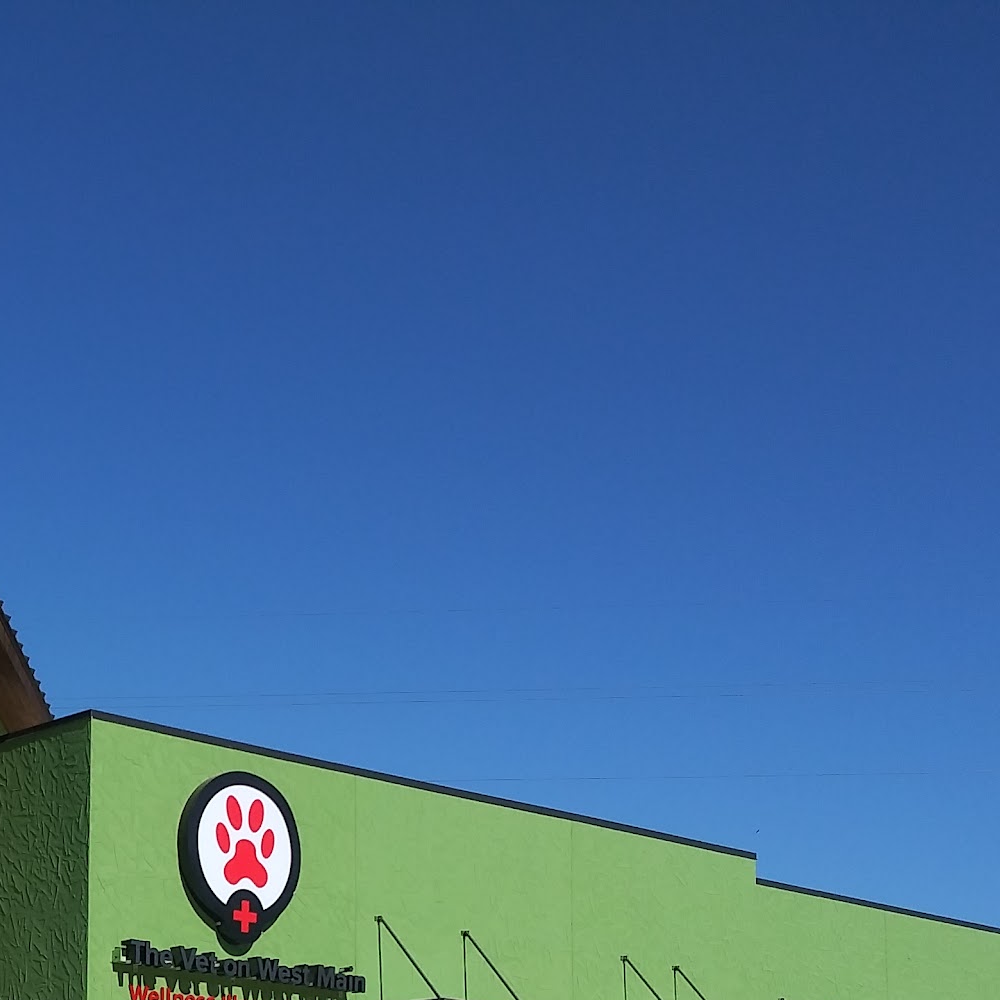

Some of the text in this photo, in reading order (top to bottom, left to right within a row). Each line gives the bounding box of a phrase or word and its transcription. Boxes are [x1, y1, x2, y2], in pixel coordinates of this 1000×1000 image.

[131, 938, 366, 993] The Vet on West Main
